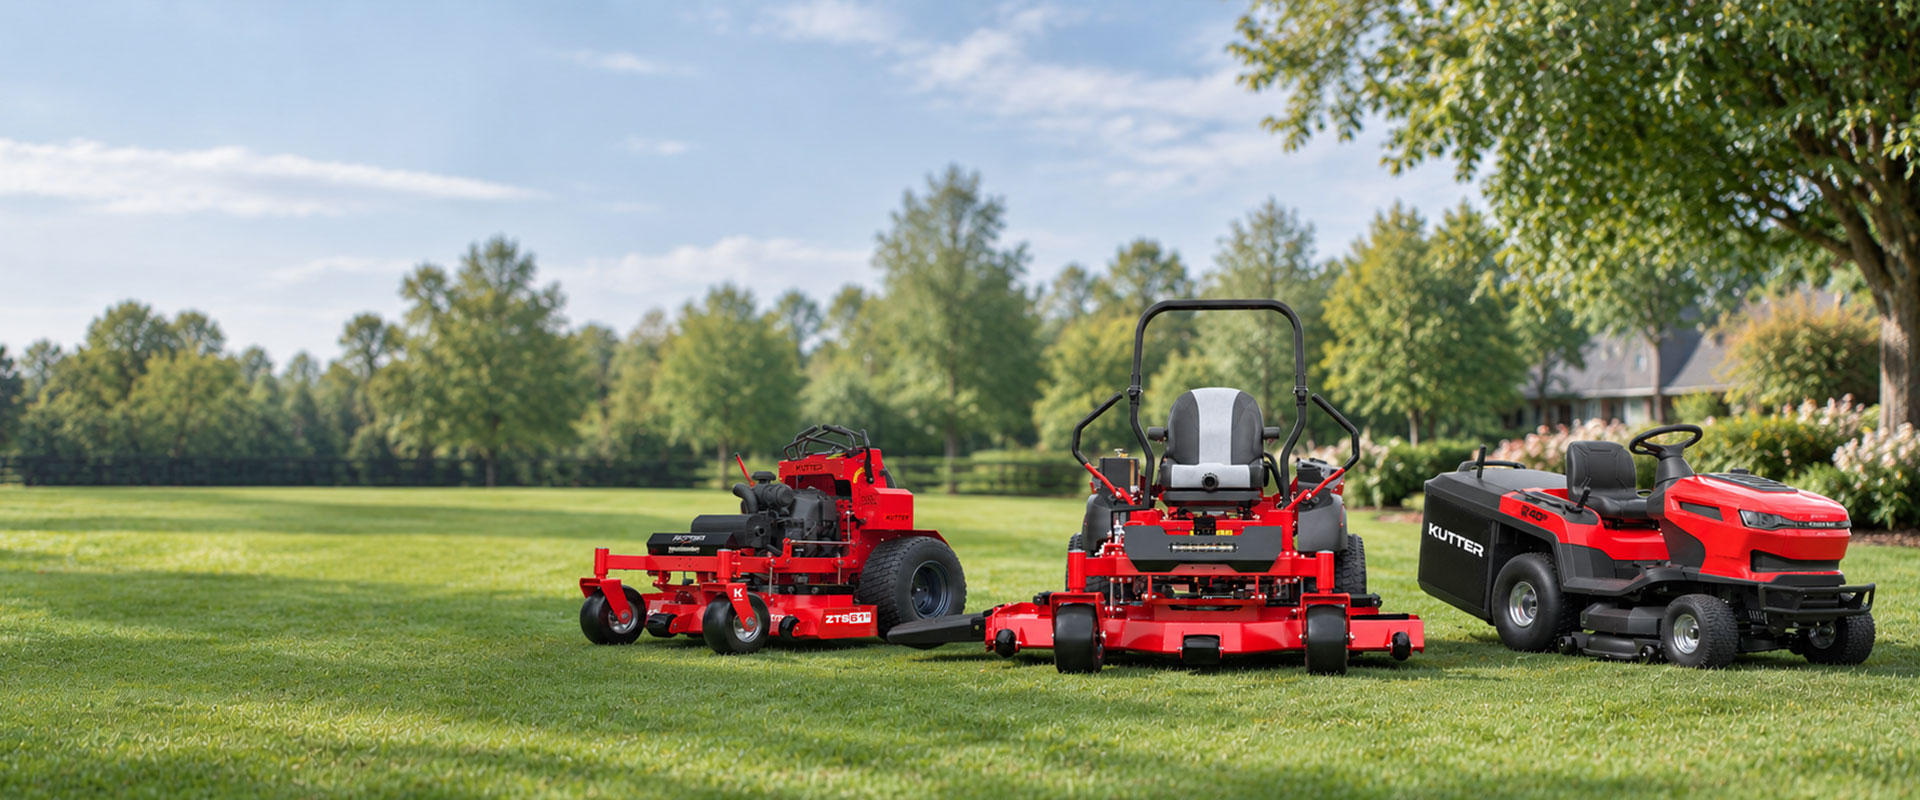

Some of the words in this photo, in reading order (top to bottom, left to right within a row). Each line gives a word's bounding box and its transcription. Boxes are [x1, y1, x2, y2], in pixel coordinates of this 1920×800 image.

[795, 464, 823, 472] KUTTER
[1428, 522, 1485, 557] KUTTER
[733, 587, 743, 598] K
